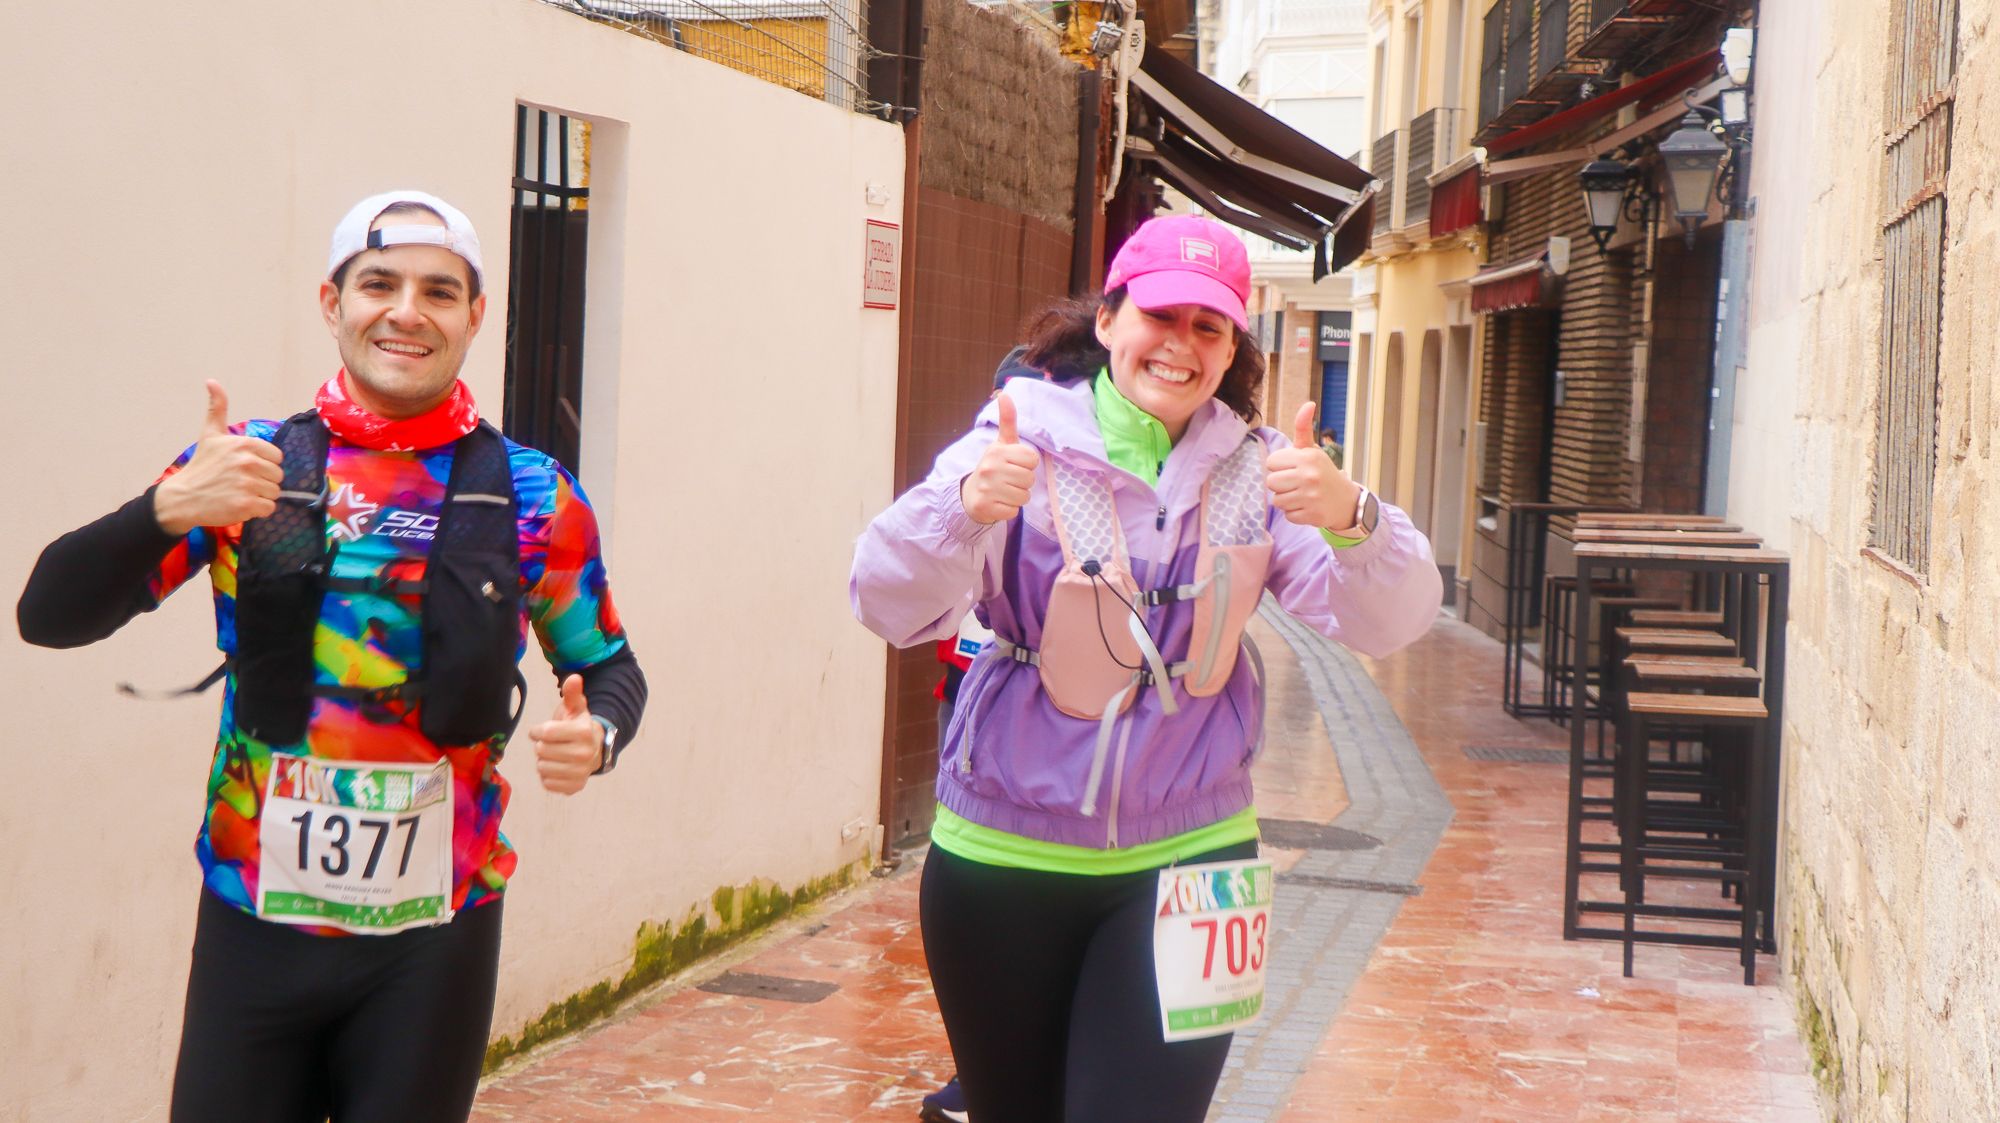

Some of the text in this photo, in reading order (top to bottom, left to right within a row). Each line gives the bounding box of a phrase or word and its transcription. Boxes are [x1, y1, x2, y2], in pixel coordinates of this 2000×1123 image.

[1321, 325, 1352, 339] Phon
[372, 525, 436, 541] LUCE
[287, 760, 341, 806] 10K
[291, 808, 421, 882] 1377
[1164, 870, 1219, 914] 10K
[1190, 911, 1267, 981] 703
